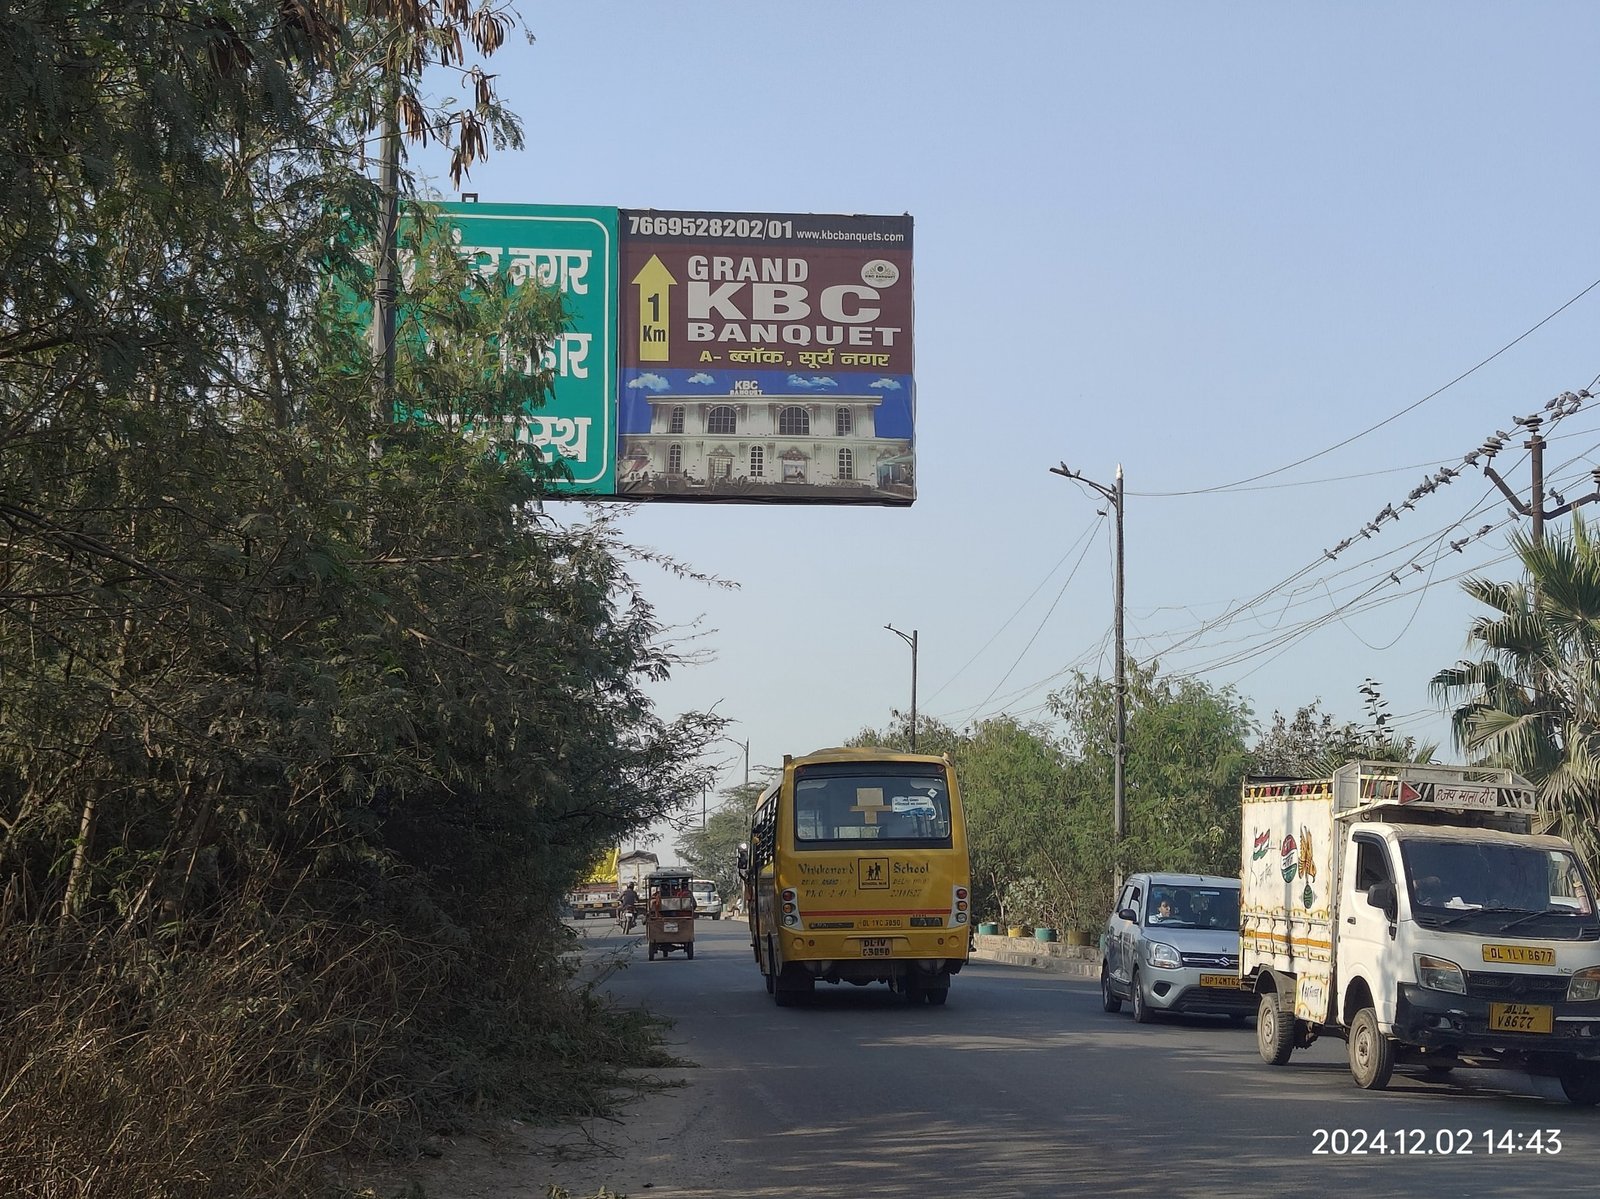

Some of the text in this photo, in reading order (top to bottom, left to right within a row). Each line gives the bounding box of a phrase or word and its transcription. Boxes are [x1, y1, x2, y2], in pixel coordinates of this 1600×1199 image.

[628, 216, 904, 242] 7669528202/01 www.kbcbanquets.com
[687, 255, 809, 283] GRAND
[648, 293, 660, 322] 1
[687, 281, 881, 324] KBC
[643, 325, 666, 342] Km
[687, 322, 902, 347] BANQUET
[700, 350, 722, 362] A-
[798, 347, 836, 369] सूर्य
[840, 352, 890, 367] नगर
[734, 380, 758, 390] KBC
[893, 861, 929, 874] School
[1491, 948, 1504, 959] DL
[1528, 951, 1553, 963] 8677
